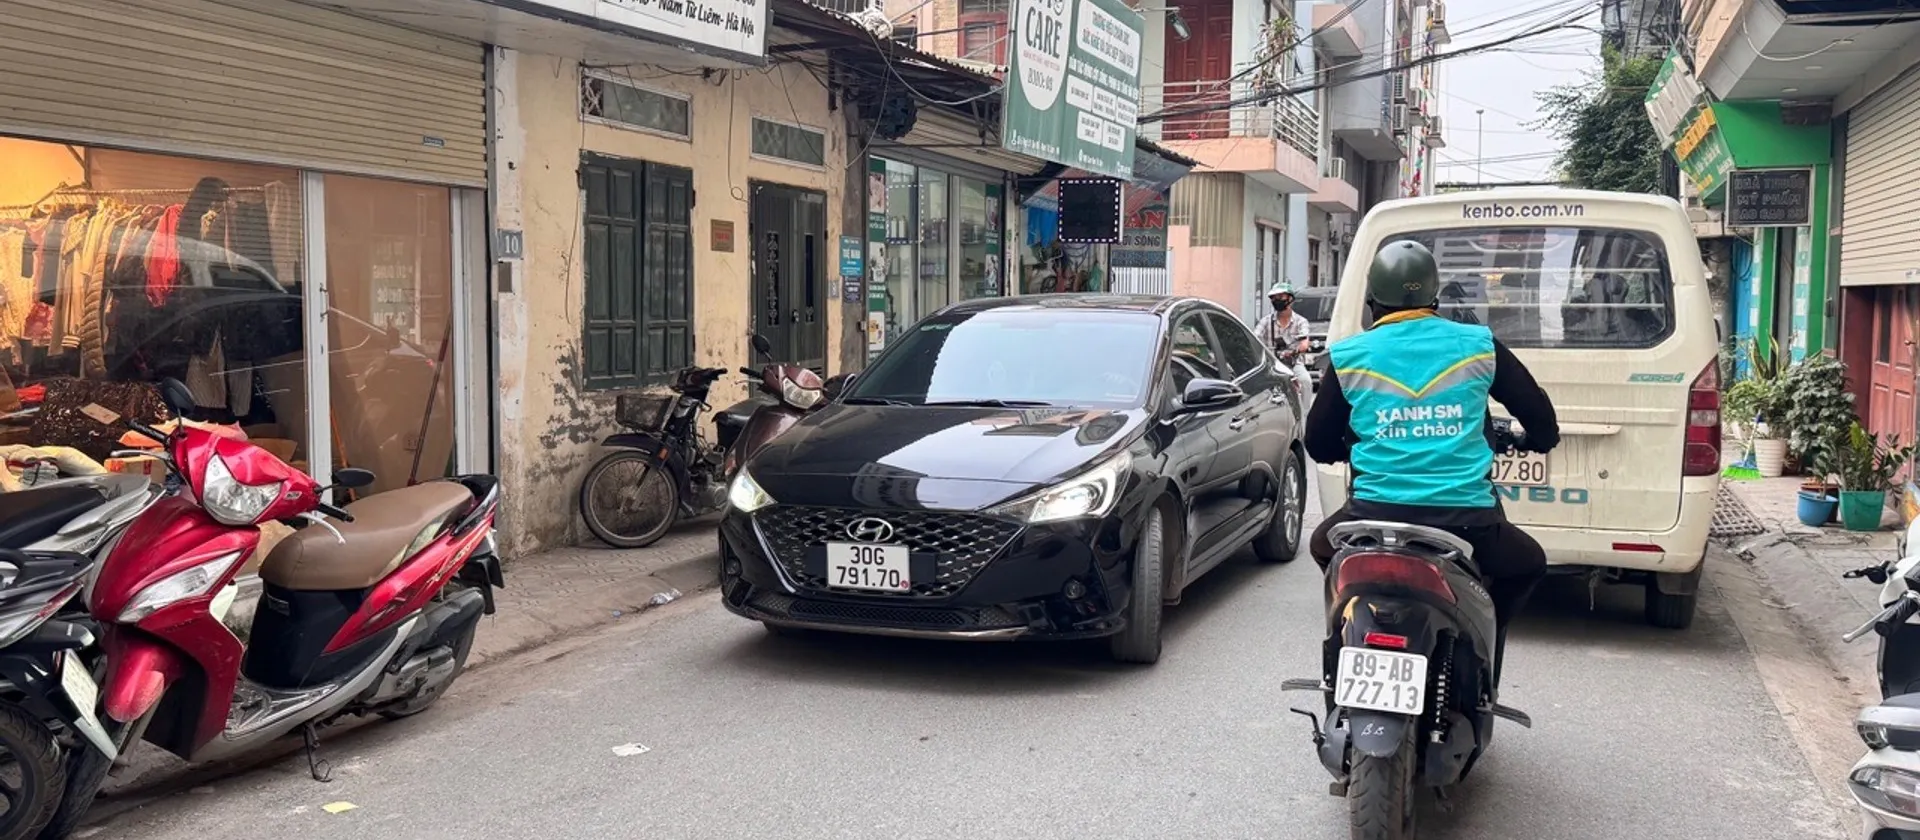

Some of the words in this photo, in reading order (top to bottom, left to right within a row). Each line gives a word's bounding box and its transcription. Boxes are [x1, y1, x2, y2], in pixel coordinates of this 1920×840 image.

[725, 12, 739, 31] Hà
[1026, 6, 1063, 59] CARE
[1123, 209, 1166, 230] AN
[1462, 203, 1584, 218] kenbo.com.vn
[505, 235, 519, 254] 10
[1376, 424, 1407, 438] xin
[1412, 421, 1464, 438] chào!
[1491, 460, 1544, 482] 07.80
[1495, 485, 1588, 504] NBO
[850, 546, 885, 566] 30G
[836, 566, 900, 588] 791.70
[1352, 653, 1414, 682] 89-AB
[1342, 678, 1418, 710] 727.13
